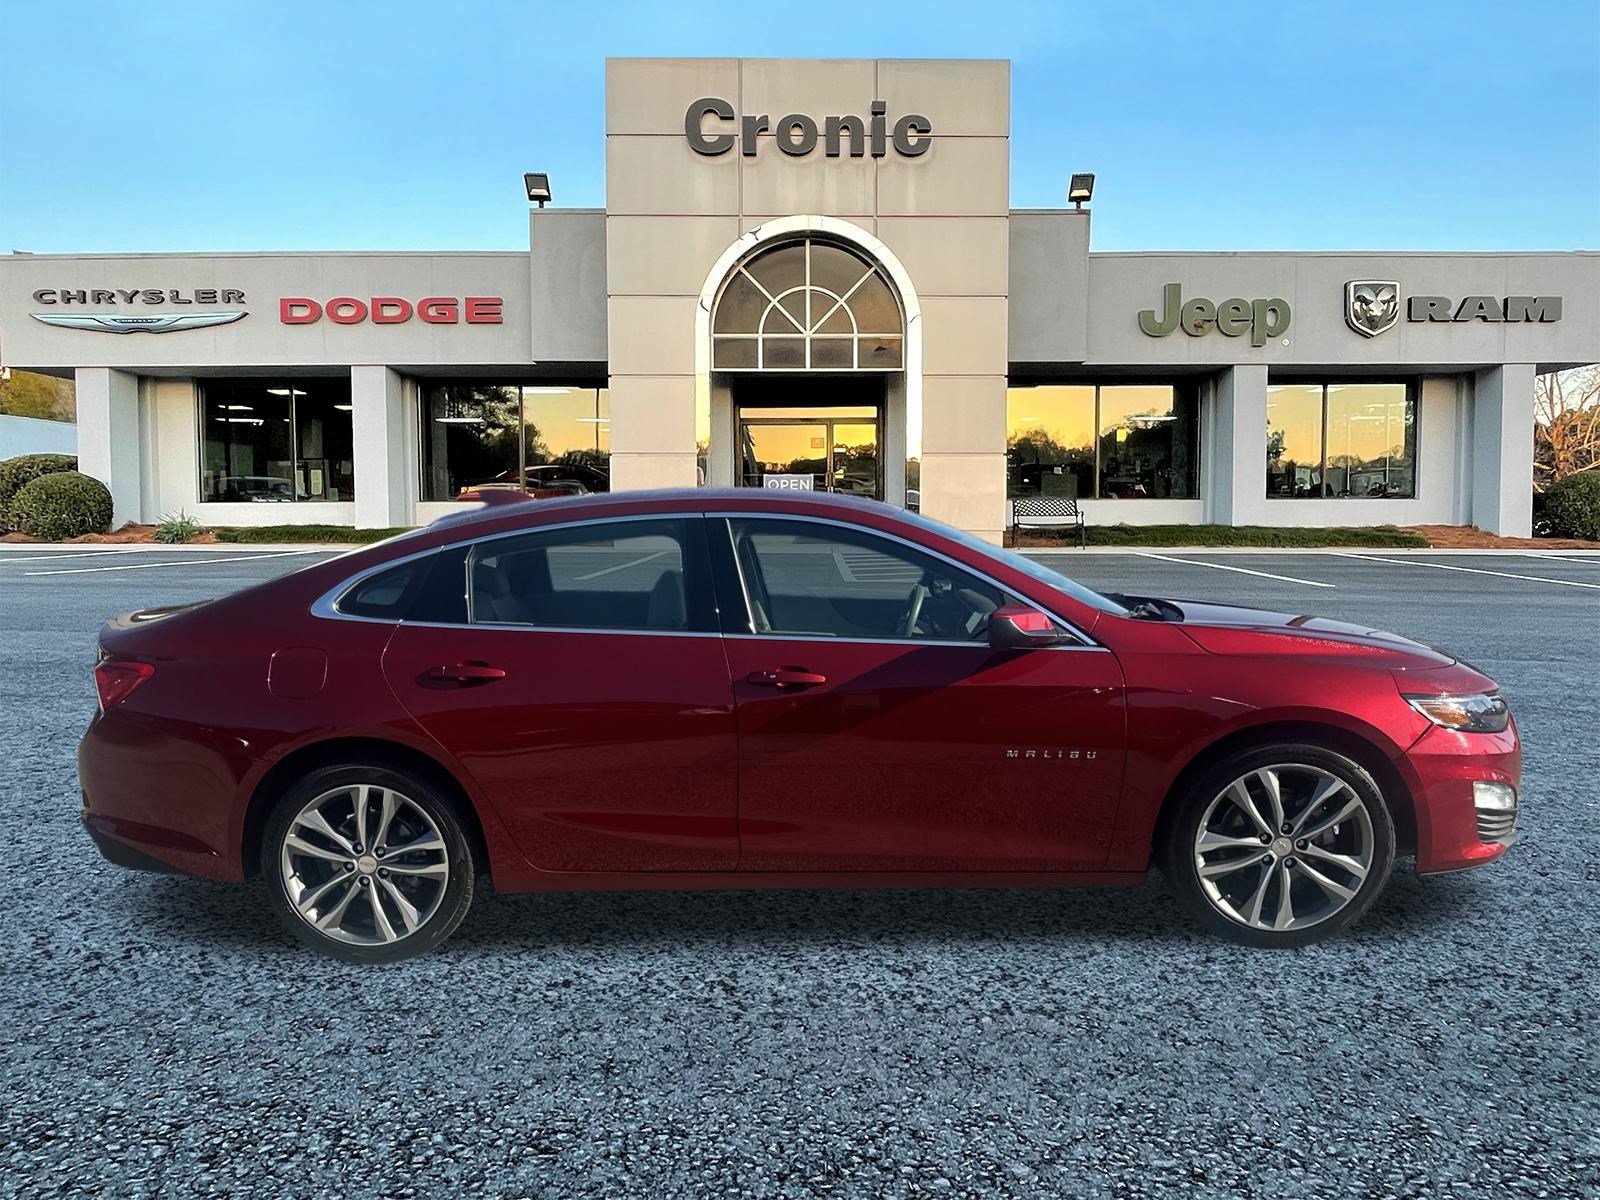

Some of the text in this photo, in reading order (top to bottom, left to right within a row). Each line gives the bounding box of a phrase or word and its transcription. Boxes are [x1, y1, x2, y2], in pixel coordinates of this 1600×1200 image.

[685, 97, 932, 157] Cronic
[32, 289, 246, 304] CHRYSLER
[1407, 296, 1562, 322] RAM
[280, 297, 503, 324] DODGE
[1138, 283, 1291, 347] Jeep
[768, 479, 810, 490] OPEN
[1006, 750, 1097, 759] MALIBU
